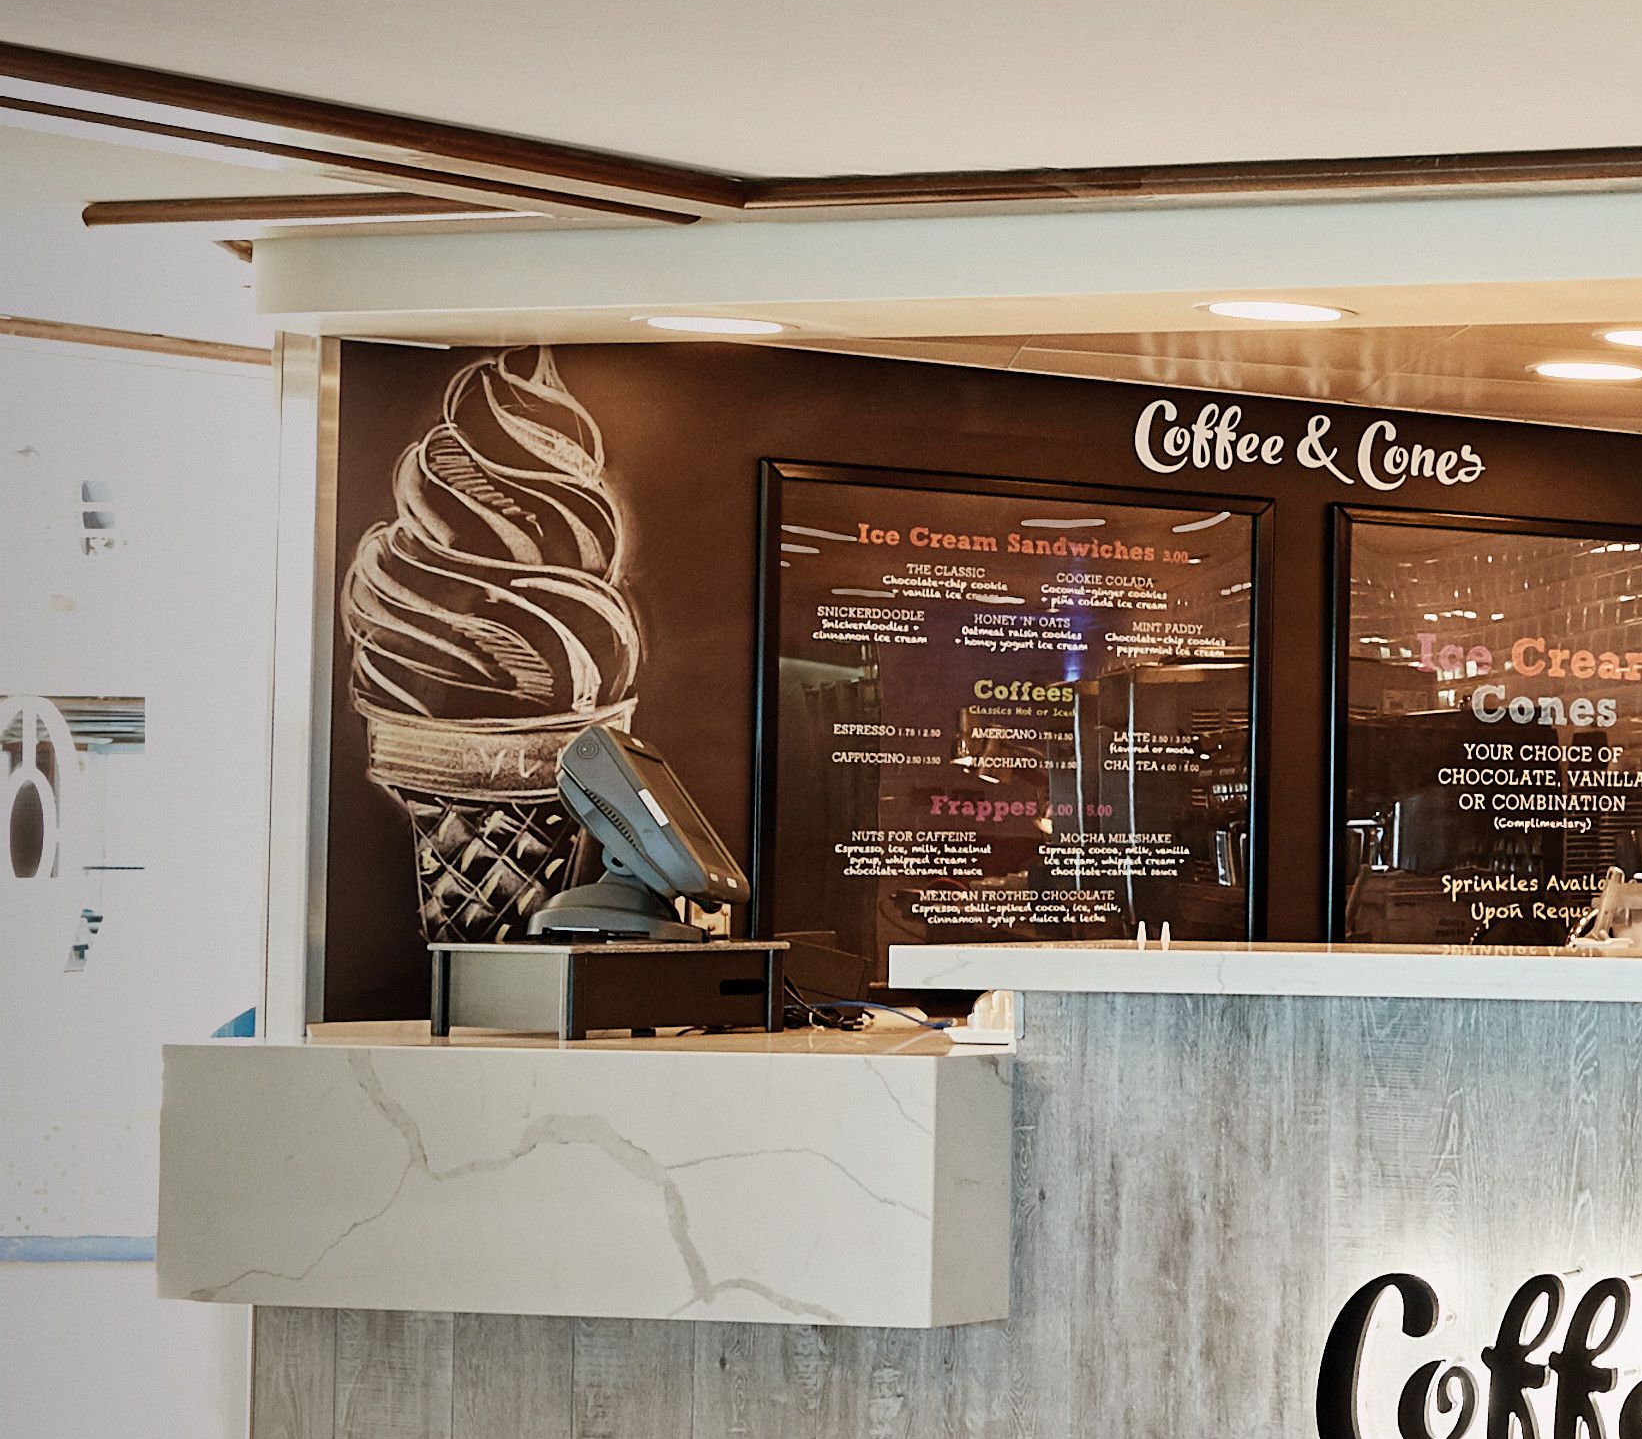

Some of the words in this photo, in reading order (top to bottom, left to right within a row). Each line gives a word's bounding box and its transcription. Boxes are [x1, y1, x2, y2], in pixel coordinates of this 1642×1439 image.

[1134, 399, 1284, 474] Coffee
[1296, 414, 1355, 486] &
[1357, 420, 1486, 491] Cones
[857, 522, 900, 545] Ice
[909, 527, 998, 552] Cream
[1007, 531, 1155, 562] Sandwiches
[906, 563, 931, 576] THE
[934, 565, 986, 579] CLASSIC
[882, 574, 967, 593] Chocolate-chip
[1056, 572, 1102, 585] COOKIE
[1105, 574, 1154, 589] COLADA
[902, 589, 941, 599] vanilla
[945, 590, 962, 600] ice
[1040, 583, 1125, 600] Coconut-ginger
[1128, 590, 1168, 600] cookies
[1078, 597, 1114, 608] colada
[1117, 599, 1133, 609] ice
[1136, 602, 1168, 610] cream
[816, 605, 925, 621] SNICKERDOODLE
[974, 613, 1017, 626] HONEY
[1038, 617, 1071, 628] OATS
[821, 619, 909, 633] Snickerdoodles
[961, 625, 1005, 637] Oatmeal
[1008, 628, 1039, 638] raisin
[1042, 629, 1082, 640] cookies
[1132, 621, 1162, 633] MINT
[1165, 622, 1203, 635] PADDY
[812, 631, 870, 642] cinnamon
[873, 632, 891, 642] ice
[894, 635, 928, 644] cream
[964, 637, 997, 652] honey
[999, 639, 1034, 652] yogurt
[1038, 640, 1053, 650] ice
[1056, 642, 1088, 651] cream
[1105, 632, 1184, 648] Chocolate-chip
[1116, 644, 1173, 658] peppermint
[1415, 632, 1493, 673] Ice
[973, 679, 1074, 702] Coffees
[968, 705, 1012, 716] Classics
[1036, 709, 1049, 717] or
[1471, 684, 1618, 728] Cones
[833, 724, 896, 737] ESPRESSO
[971, 727, 1037, 740] AMERICANO
[1113, 732, 1151, 744] LATE
[831, 751, 905, 765] CAPPUCCINO
[1463, 743, 1514, 761] YOUR
[1520, 745, 1593, 762] CHOICE
[1598, 746, 1624, 763] OF
[1103, 760, 1133, 771] CHA
[1135, 761, 1158, 771] TEA
[1437, 768, 1561, 787] CHOCOLATE,
[930, 795, 1037, 821] Frappes
[1087, 805, 1112, 817] 5.00
[1458, 793, 1486, 810] OR
[1491, 794, 1627, 811] COMBINATION
[1494, 816, 1592, 833] (Complimentary)
[851, 831, 884, 842] NUTS
[888, 831, 912, 842] FOR
[916, 831, 976, 842] CAFFEINE
[1060, 832, 1105, 844] MOCHA
[834, 843, 884, 857] Espresso,
[944, 844, 991, 854] hazelnut
[1038, 845, 1085, 859] Espresso,
[1155, 846, 1190, 855] vanilla
[885, 855, 929, 869] whipped
[843, 866, 948, 876] chocolate-caramel
[952, 868, 983, 876] sauce
[1150, 869, 1178, 877] sauce
[1441, 873, 1539, 902] Sprinkles
[1546, 873, 1607, 892] Availa
[919, 890, 979, 901] MEXICAN
[981, 890, 1038, 901] FROTHED
[1041, 890, 1115, 901] CHOCOLATE
[927, 915, 982, 924] cinnamon
[986, 915, 1016, 928] syrup
[1029, 913, 1059, 923] dulce
[1063, 913, 1077, 923] de
[1079, 913, 1106, 923] leche
[1470, 901, 1524, 929] Upon
[1532, 902, 1592, 927] Reque
